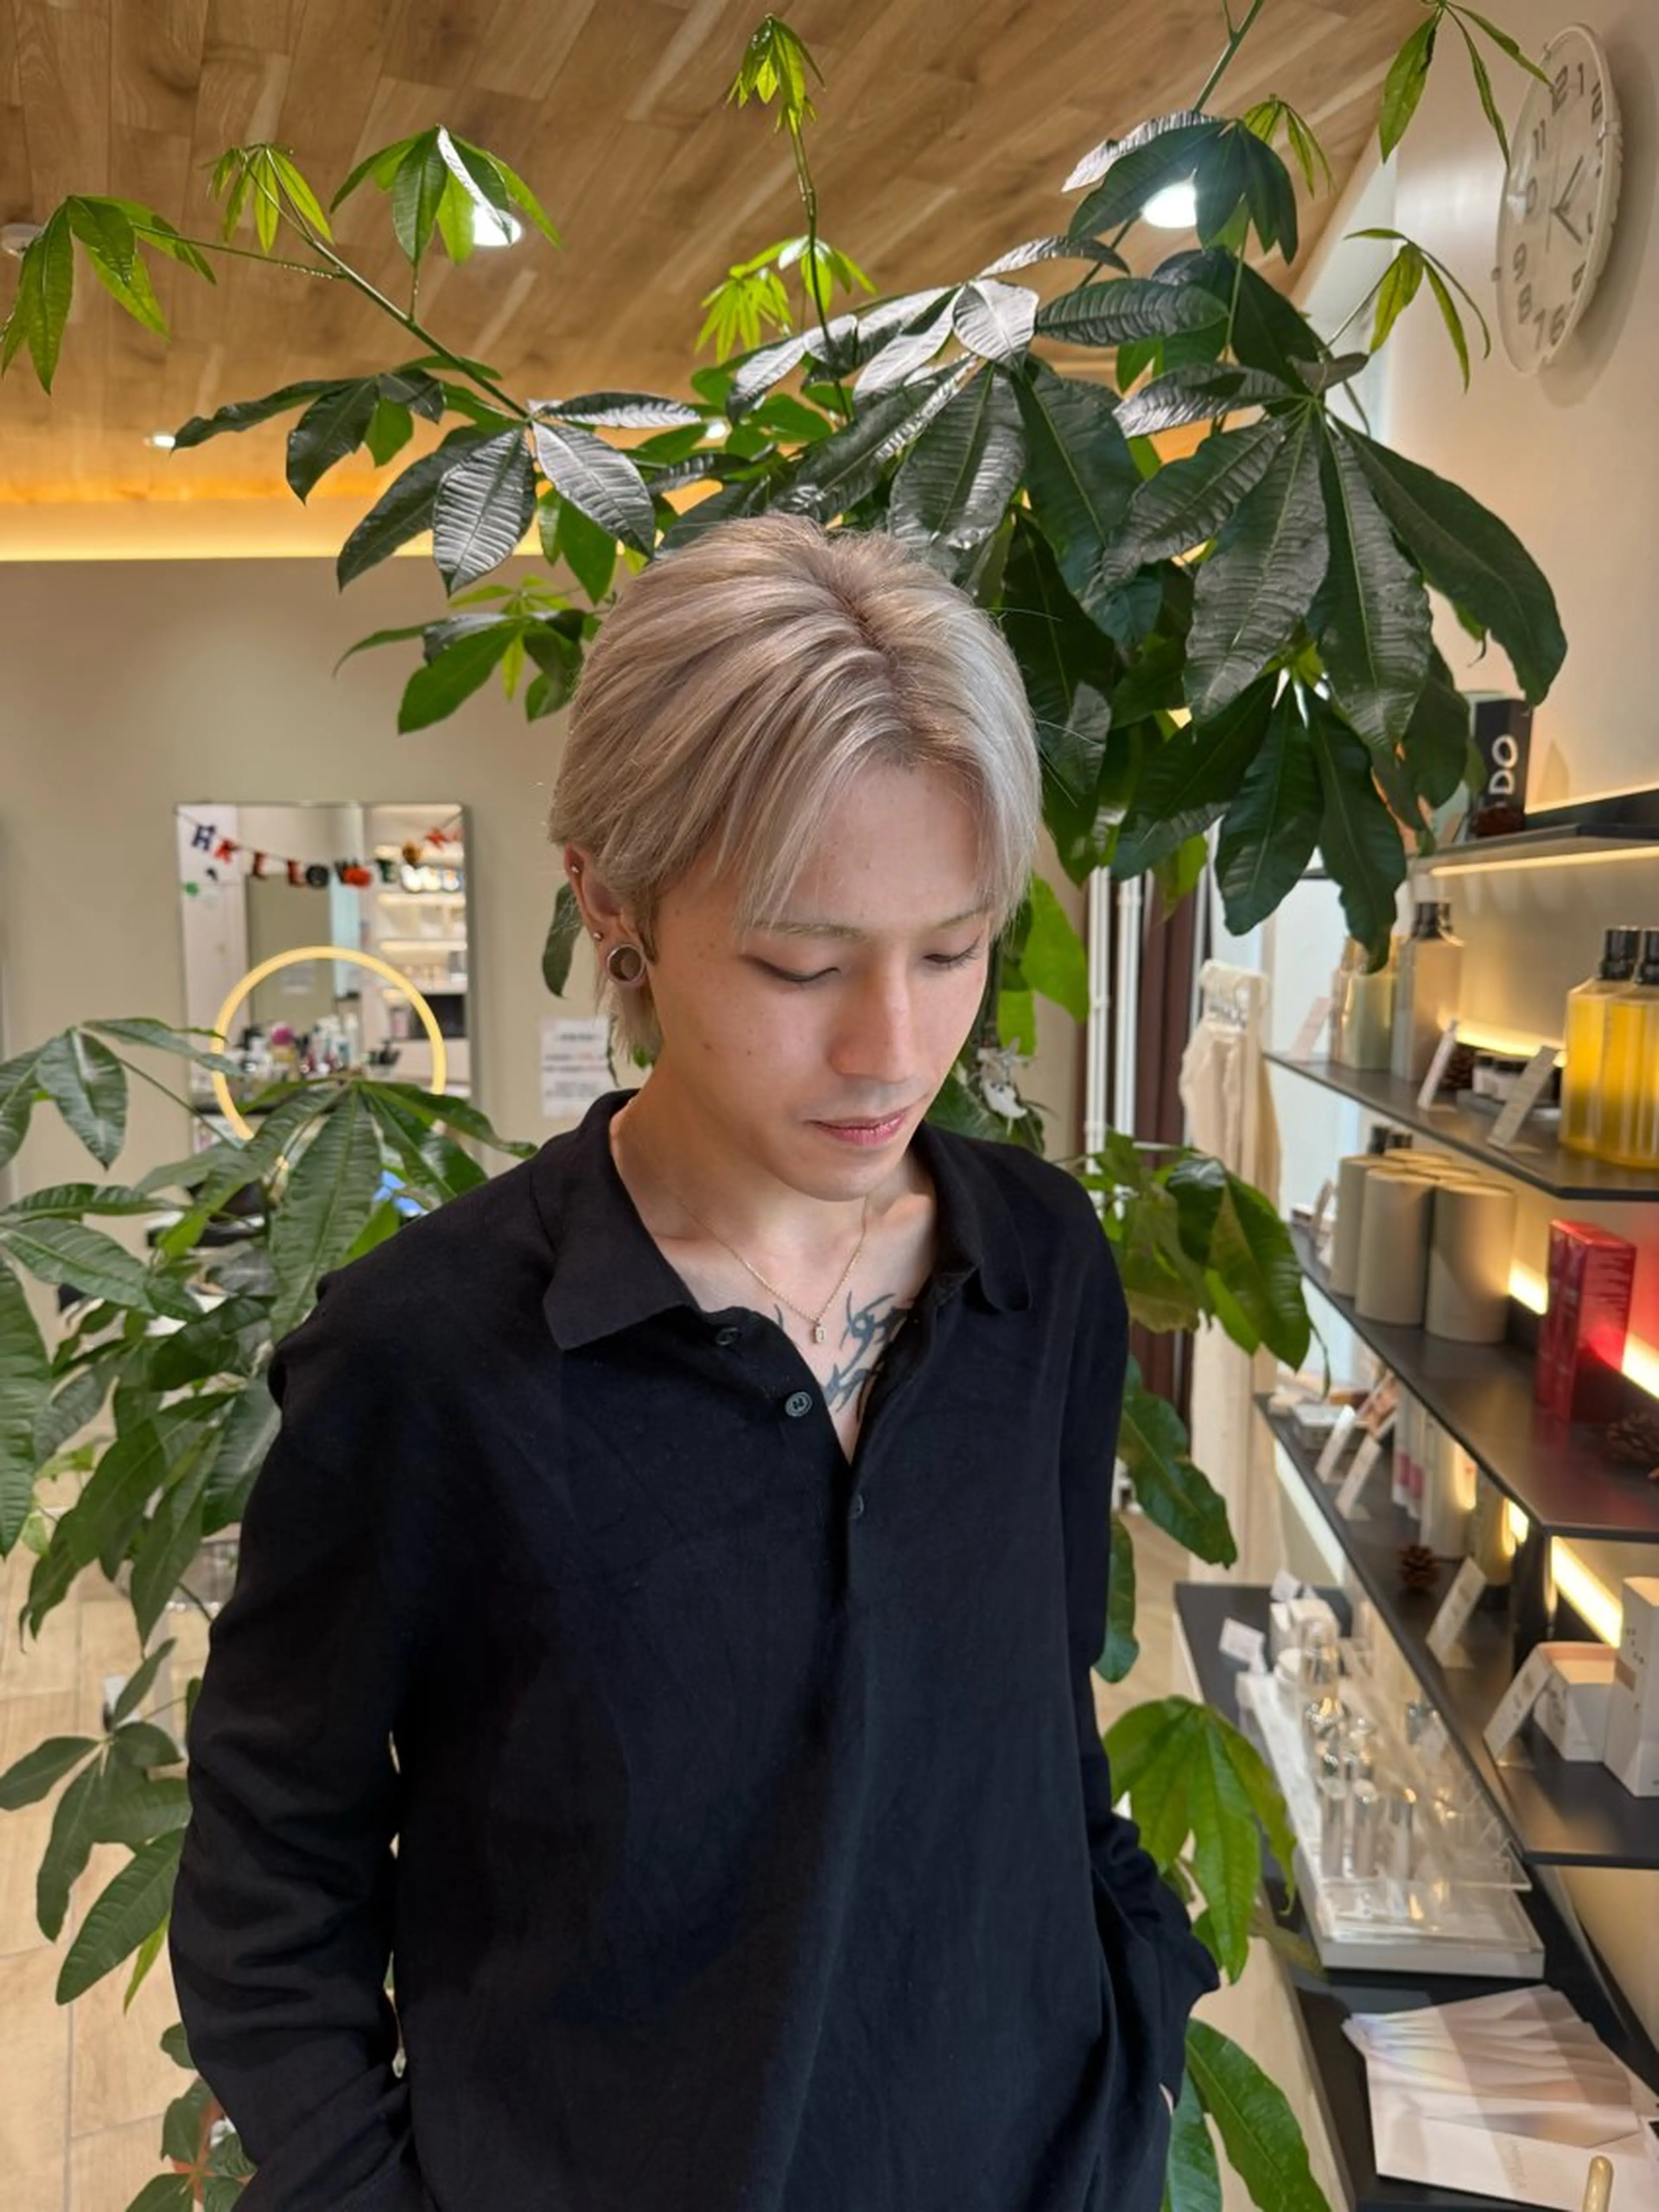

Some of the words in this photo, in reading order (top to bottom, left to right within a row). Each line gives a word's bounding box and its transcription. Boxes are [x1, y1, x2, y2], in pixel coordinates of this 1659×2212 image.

[1578, 62, 1584, 97] 1
[1532, 118, 1546, 161] 11
[1513, 242, 1527, 283] 9
[1516, 282, 1532, 325] 8
[1533, 307, 1546, 351] 7
